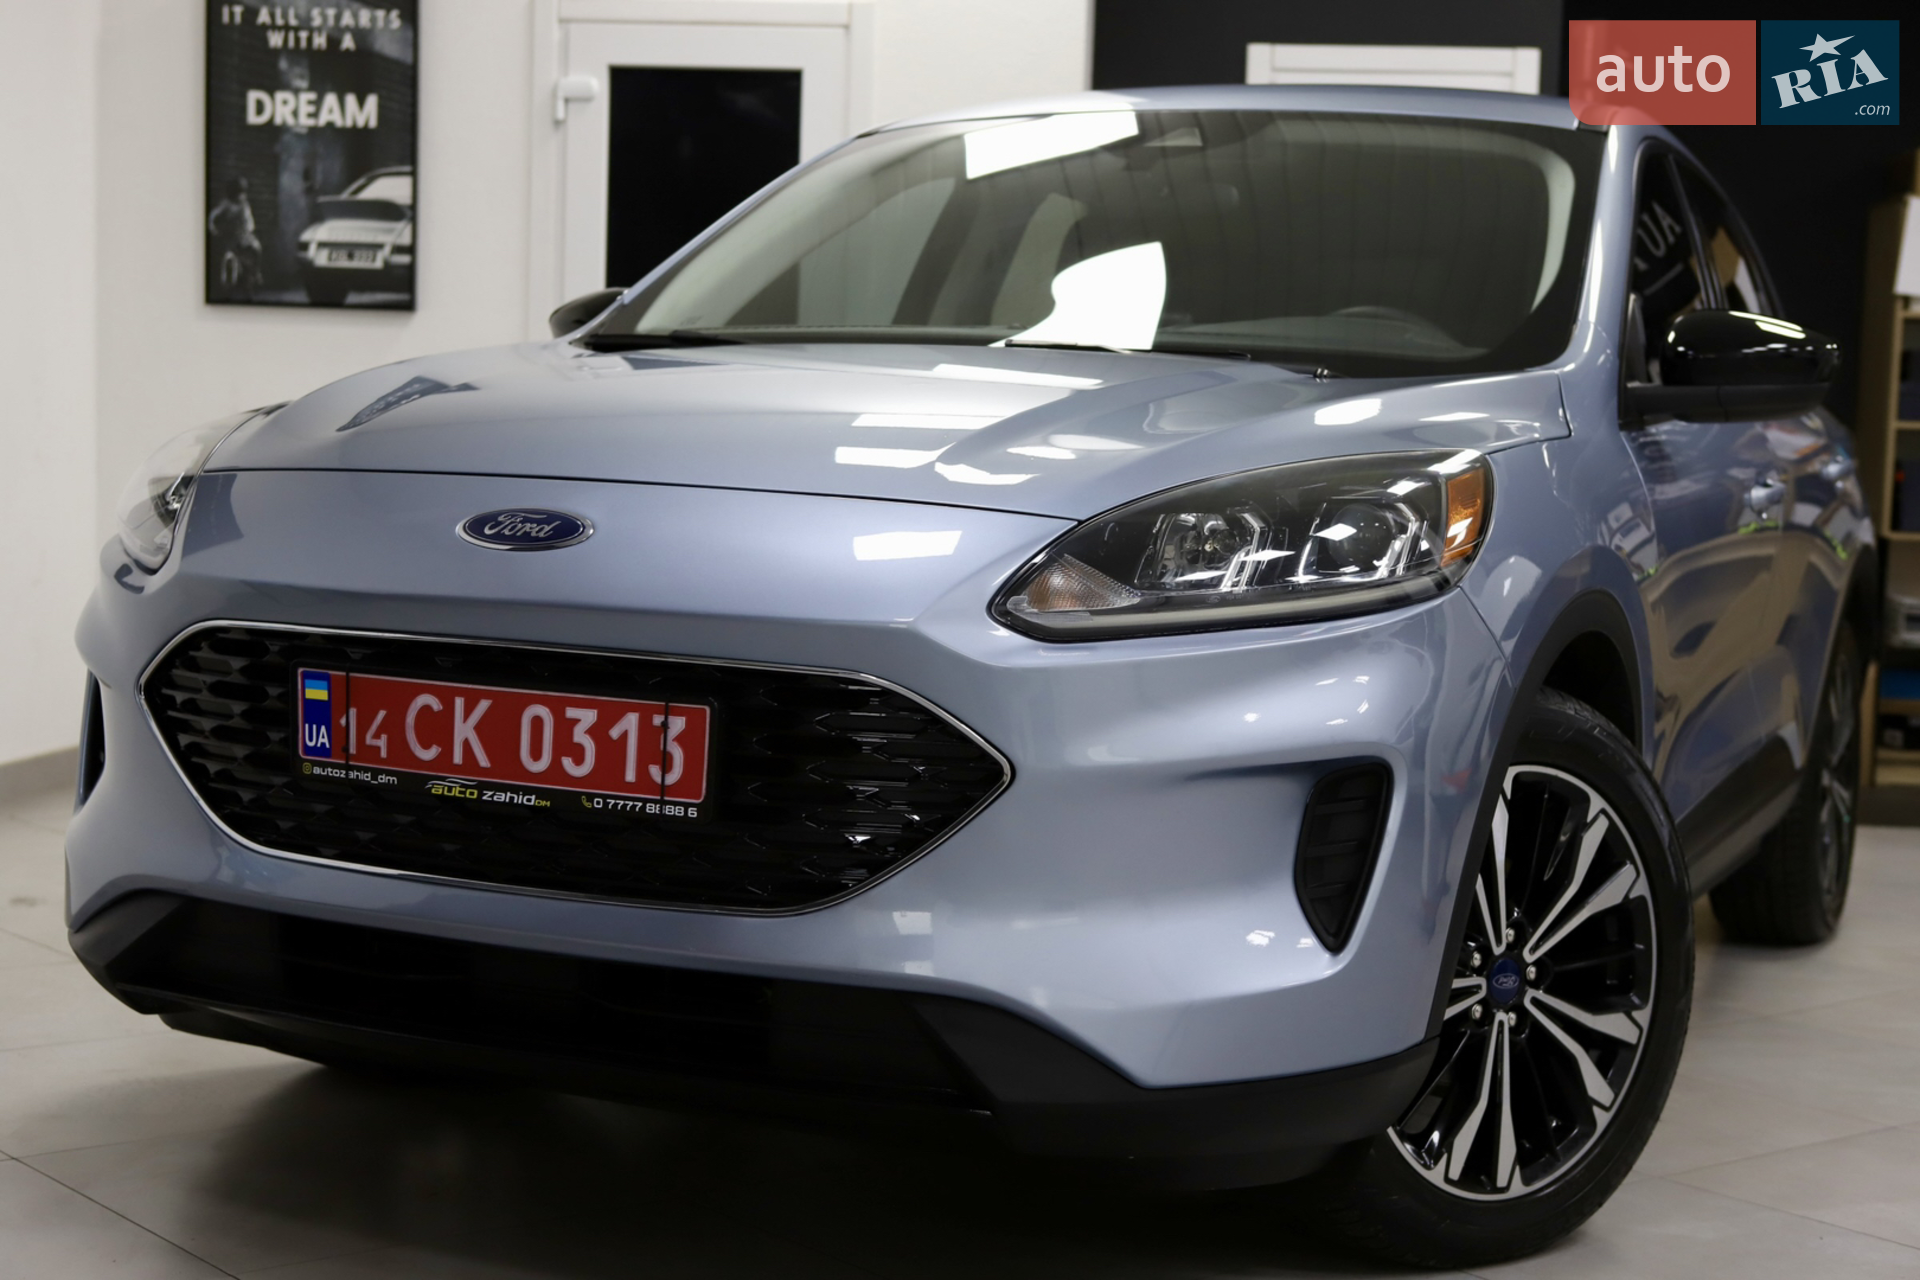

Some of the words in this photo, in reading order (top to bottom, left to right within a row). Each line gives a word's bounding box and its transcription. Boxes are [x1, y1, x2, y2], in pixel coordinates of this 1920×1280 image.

[222, 4, 245, 25] IT
[255, 5, 299, 27] ALL
[310, 7, 402, 30] STARTS
[266, 29, 328, 51] WITH
[339, 31, 356, 52] A
[245, 89, 379, 129] DREAM
[484, 512, 562, 538] Ford
[304, 723, 330, 749] UA
[339, 707, 388, 759] 14
[404, 693, 493, 768] CK
[519, 703, 686, 786] 0313
[431, 784, 478, 799] auto
[593, 797, 603, 809] 0
[606, 799, 643, 812] 7777
[687, 807, 698, 818] 6
